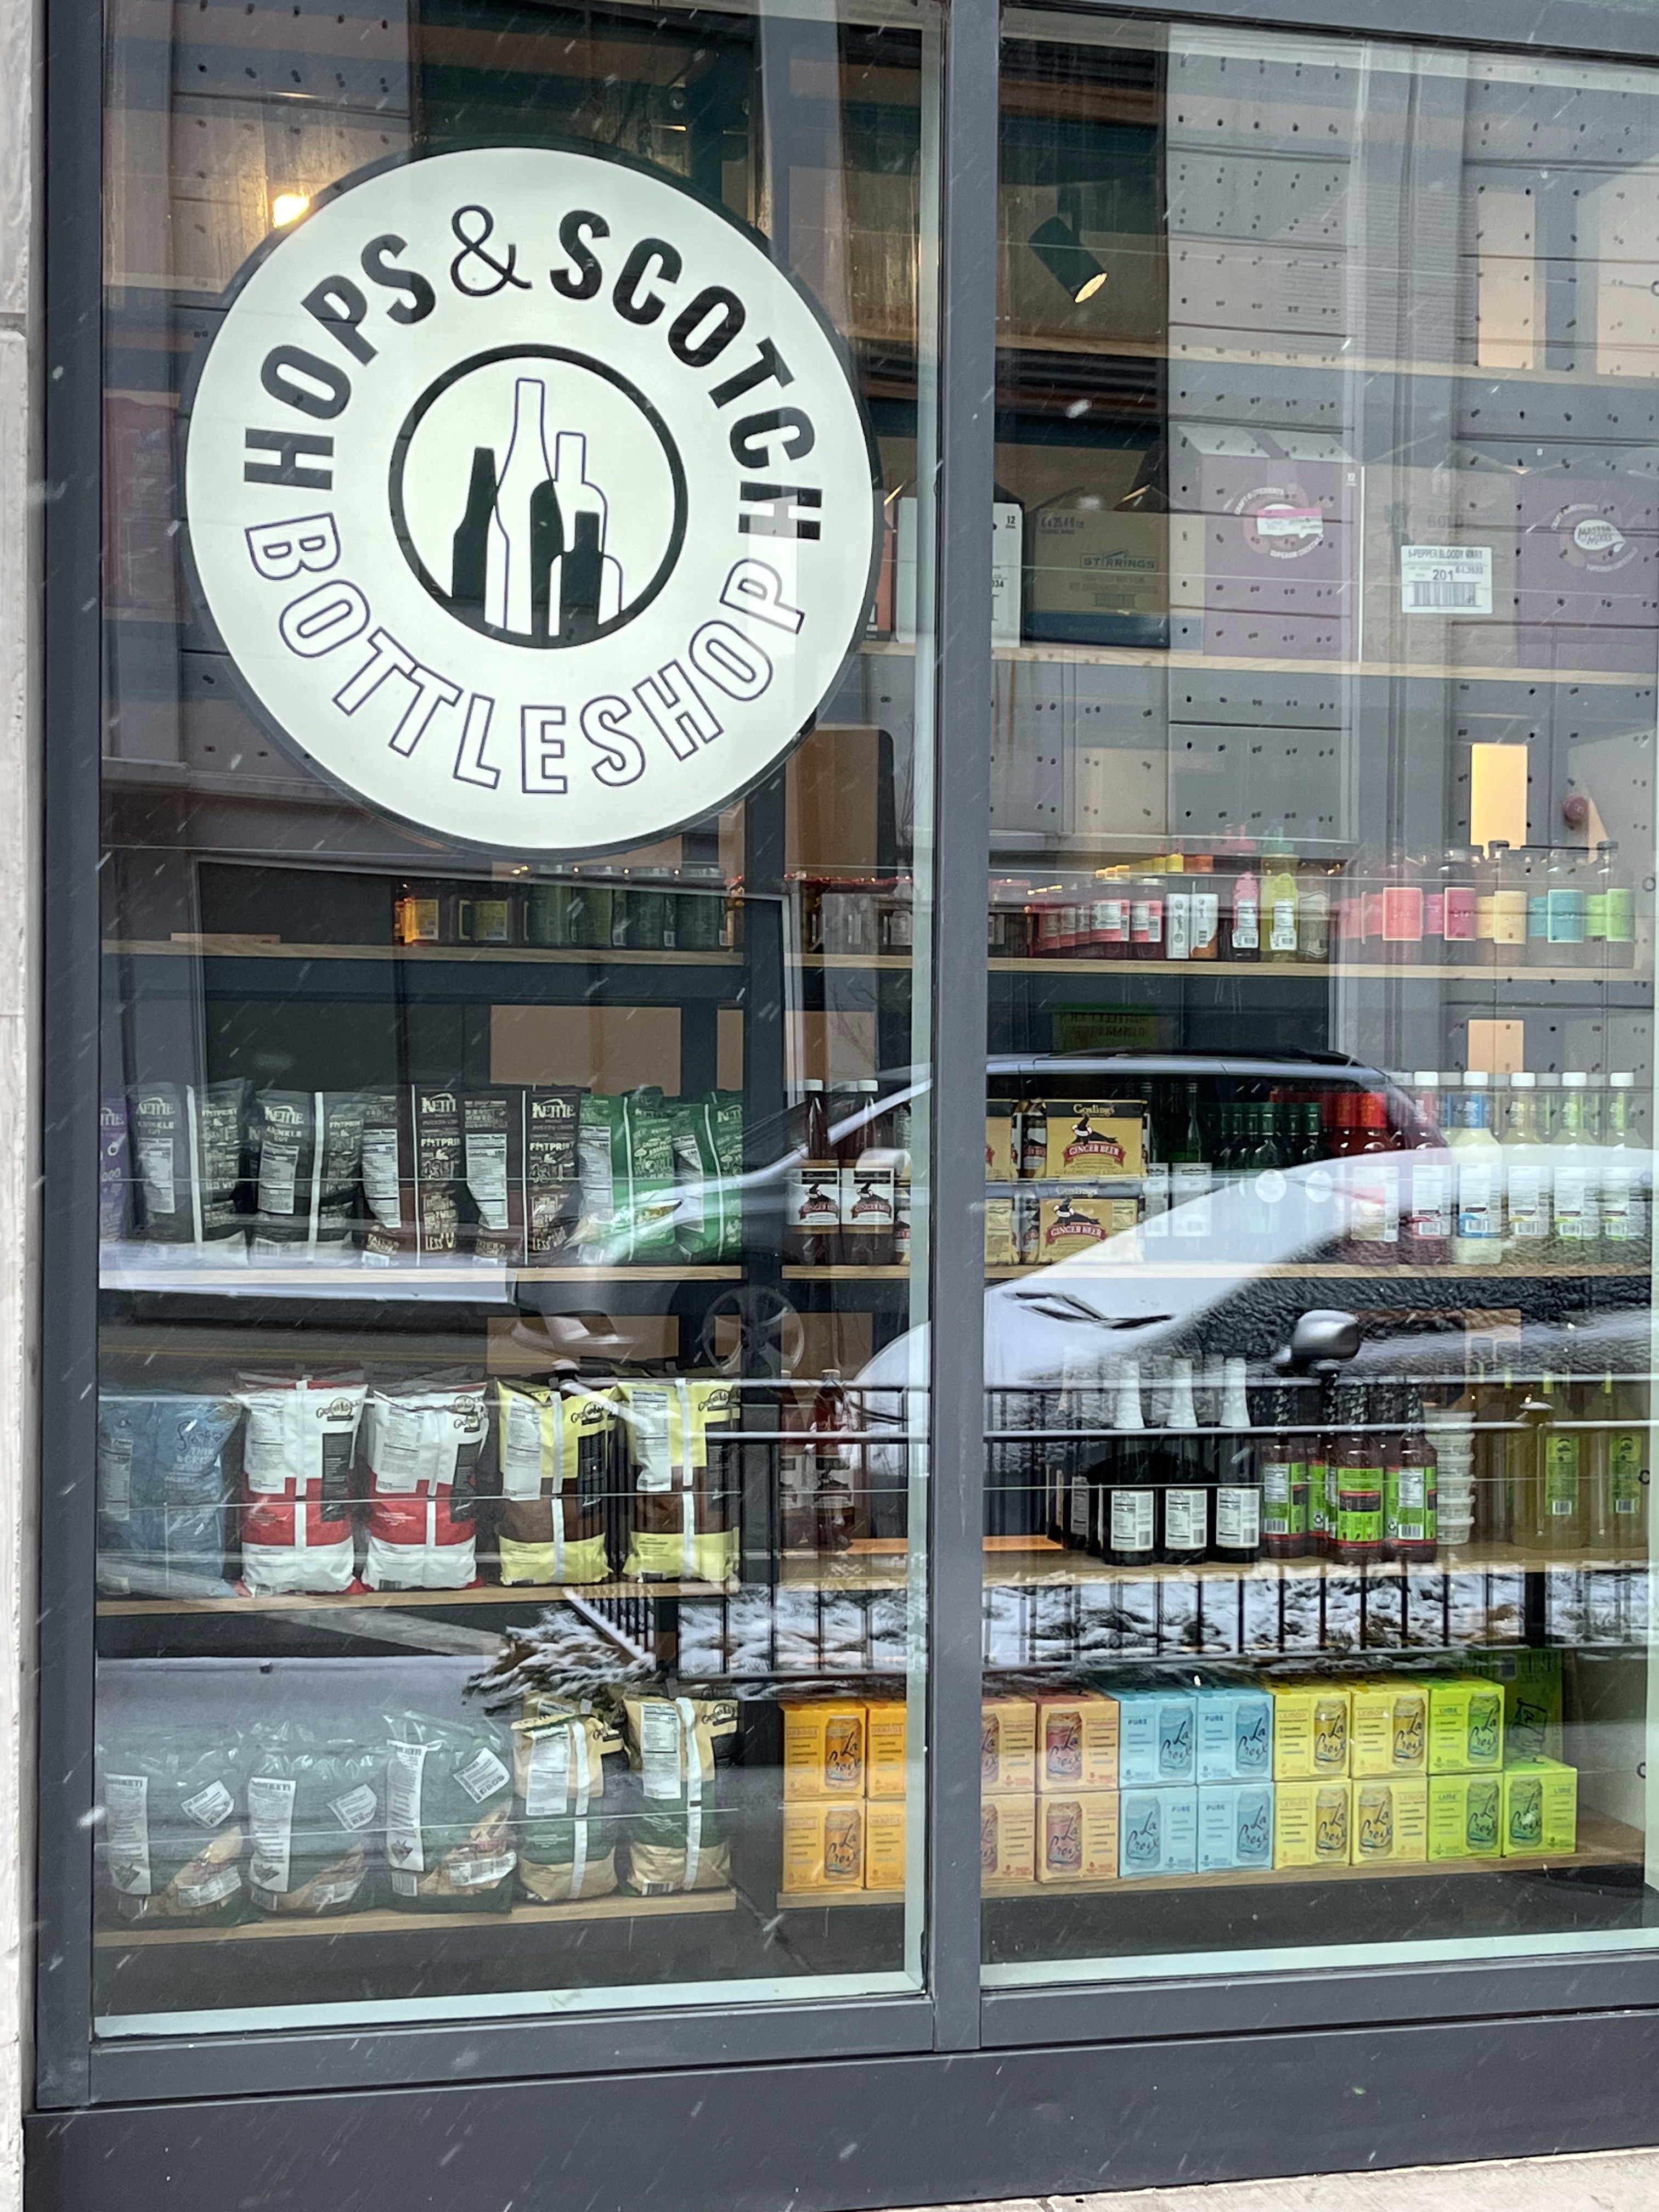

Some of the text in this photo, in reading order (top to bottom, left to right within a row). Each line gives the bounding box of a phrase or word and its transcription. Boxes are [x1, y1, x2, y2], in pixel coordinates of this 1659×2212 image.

[243, 204, 823, 541] HOPS & SCOTCH
[1007, 515, 1015, 524] 12
[1083, 556, 1155, 569] STIRRINGS
[1432, 569, 1454, 581] 201
[244, 511, 806, 794] BOTTLESHOP
[1069, 1144, 1120, 1155] GINGER BEER
[1051, 1226, 1102, 1237] GINGER BEER
